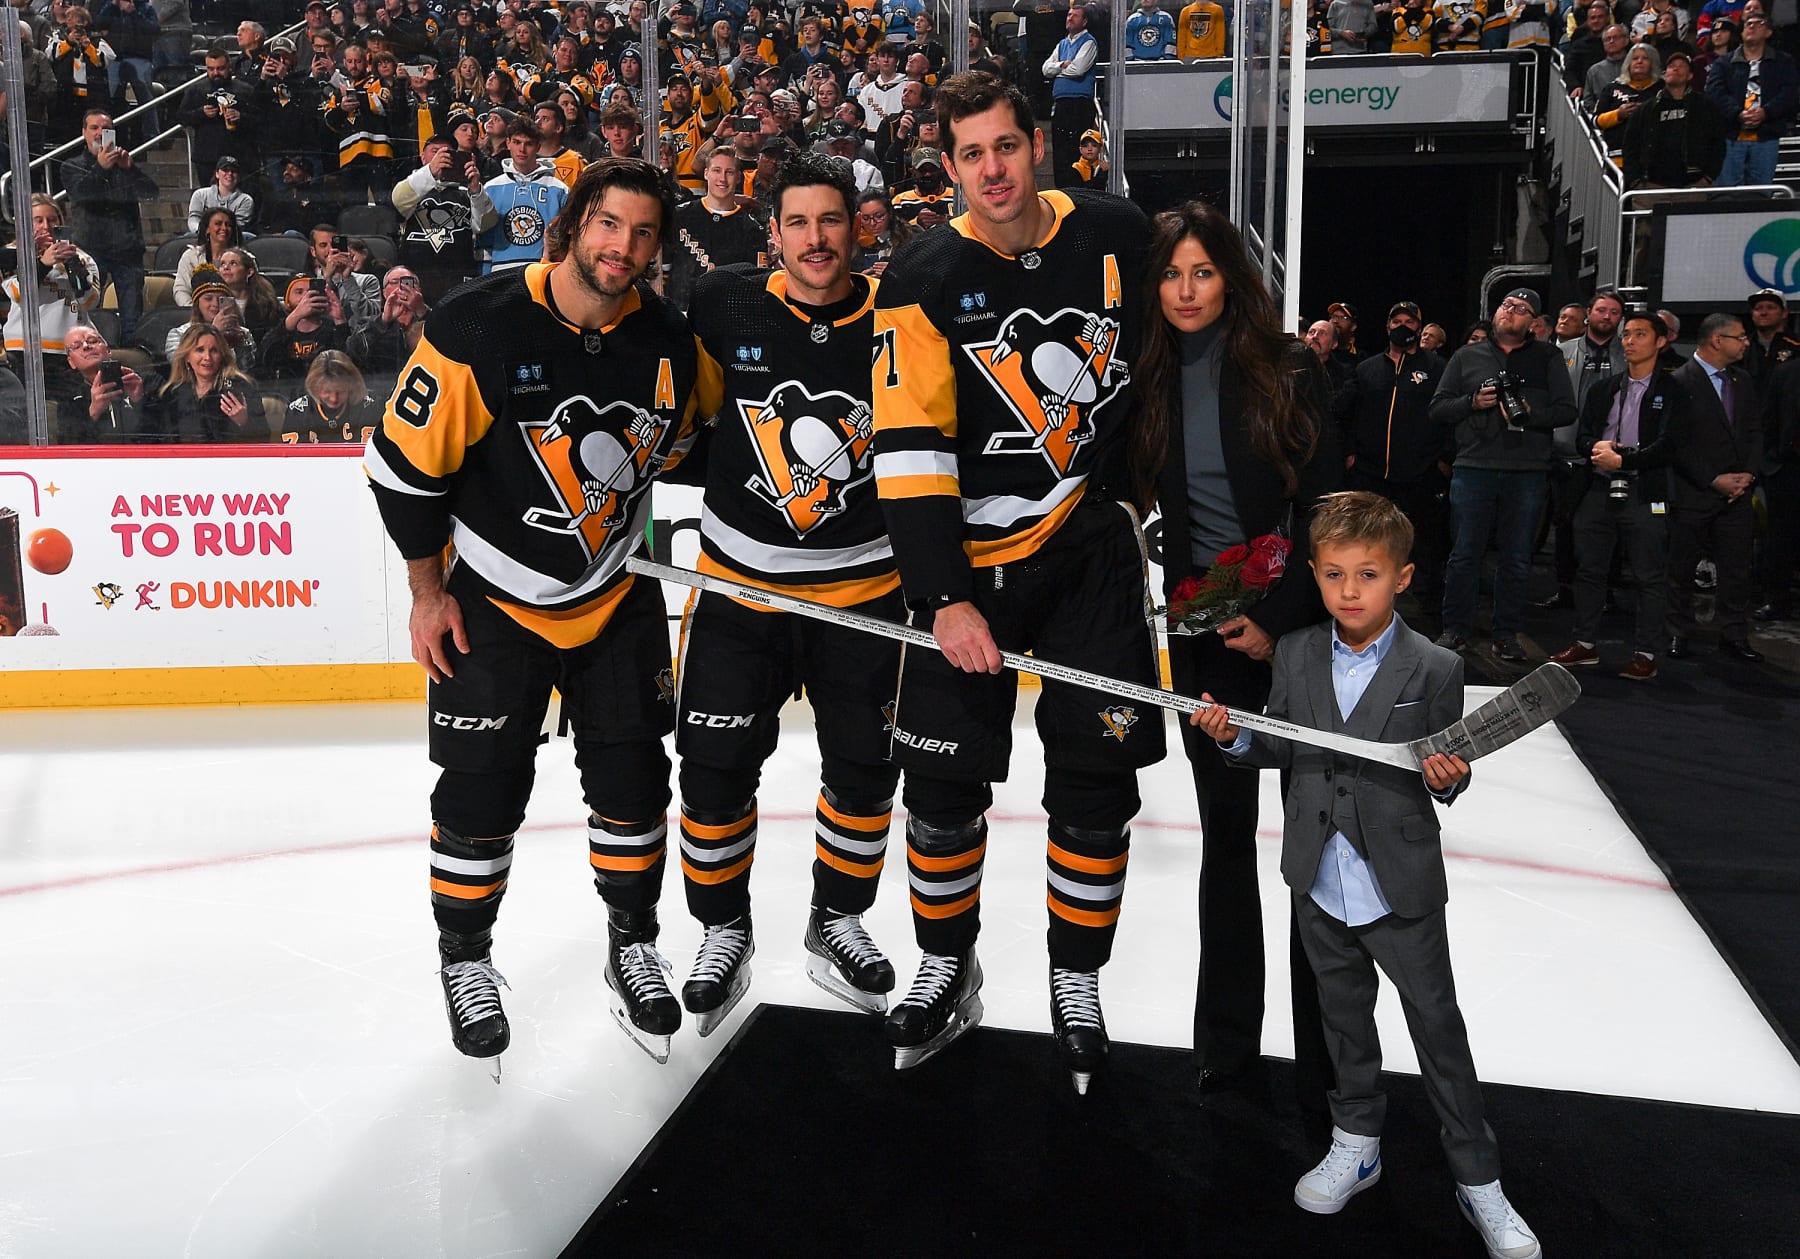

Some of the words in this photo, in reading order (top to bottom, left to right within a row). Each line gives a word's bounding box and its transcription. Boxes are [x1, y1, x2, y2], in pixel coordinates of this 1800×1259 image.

[538, 187, 548, 202] C
[1104, 254, 1122, 309] A
[958, 312, 998, 324] HIGHMARK
[655, 358, 676, 409] A
[342, 422, 353, 440] C
[111, 495, 133, 517] A
[141, 494, 214, 517] NEW
[222, 493, 290, 516] WAY
[111, 522, 179, 557] TO
[194, 521, 292, 557] RUN
[170, 579, 320, 609] DUNKIN'
[738, 590, 771, 604] PENGUINS
[434, 711, 509, 731] CCM
[687, 710, 756, 729] CCM
[893, 726, 959, 755] BAUER
[822, 944, 842, 966] CCM
